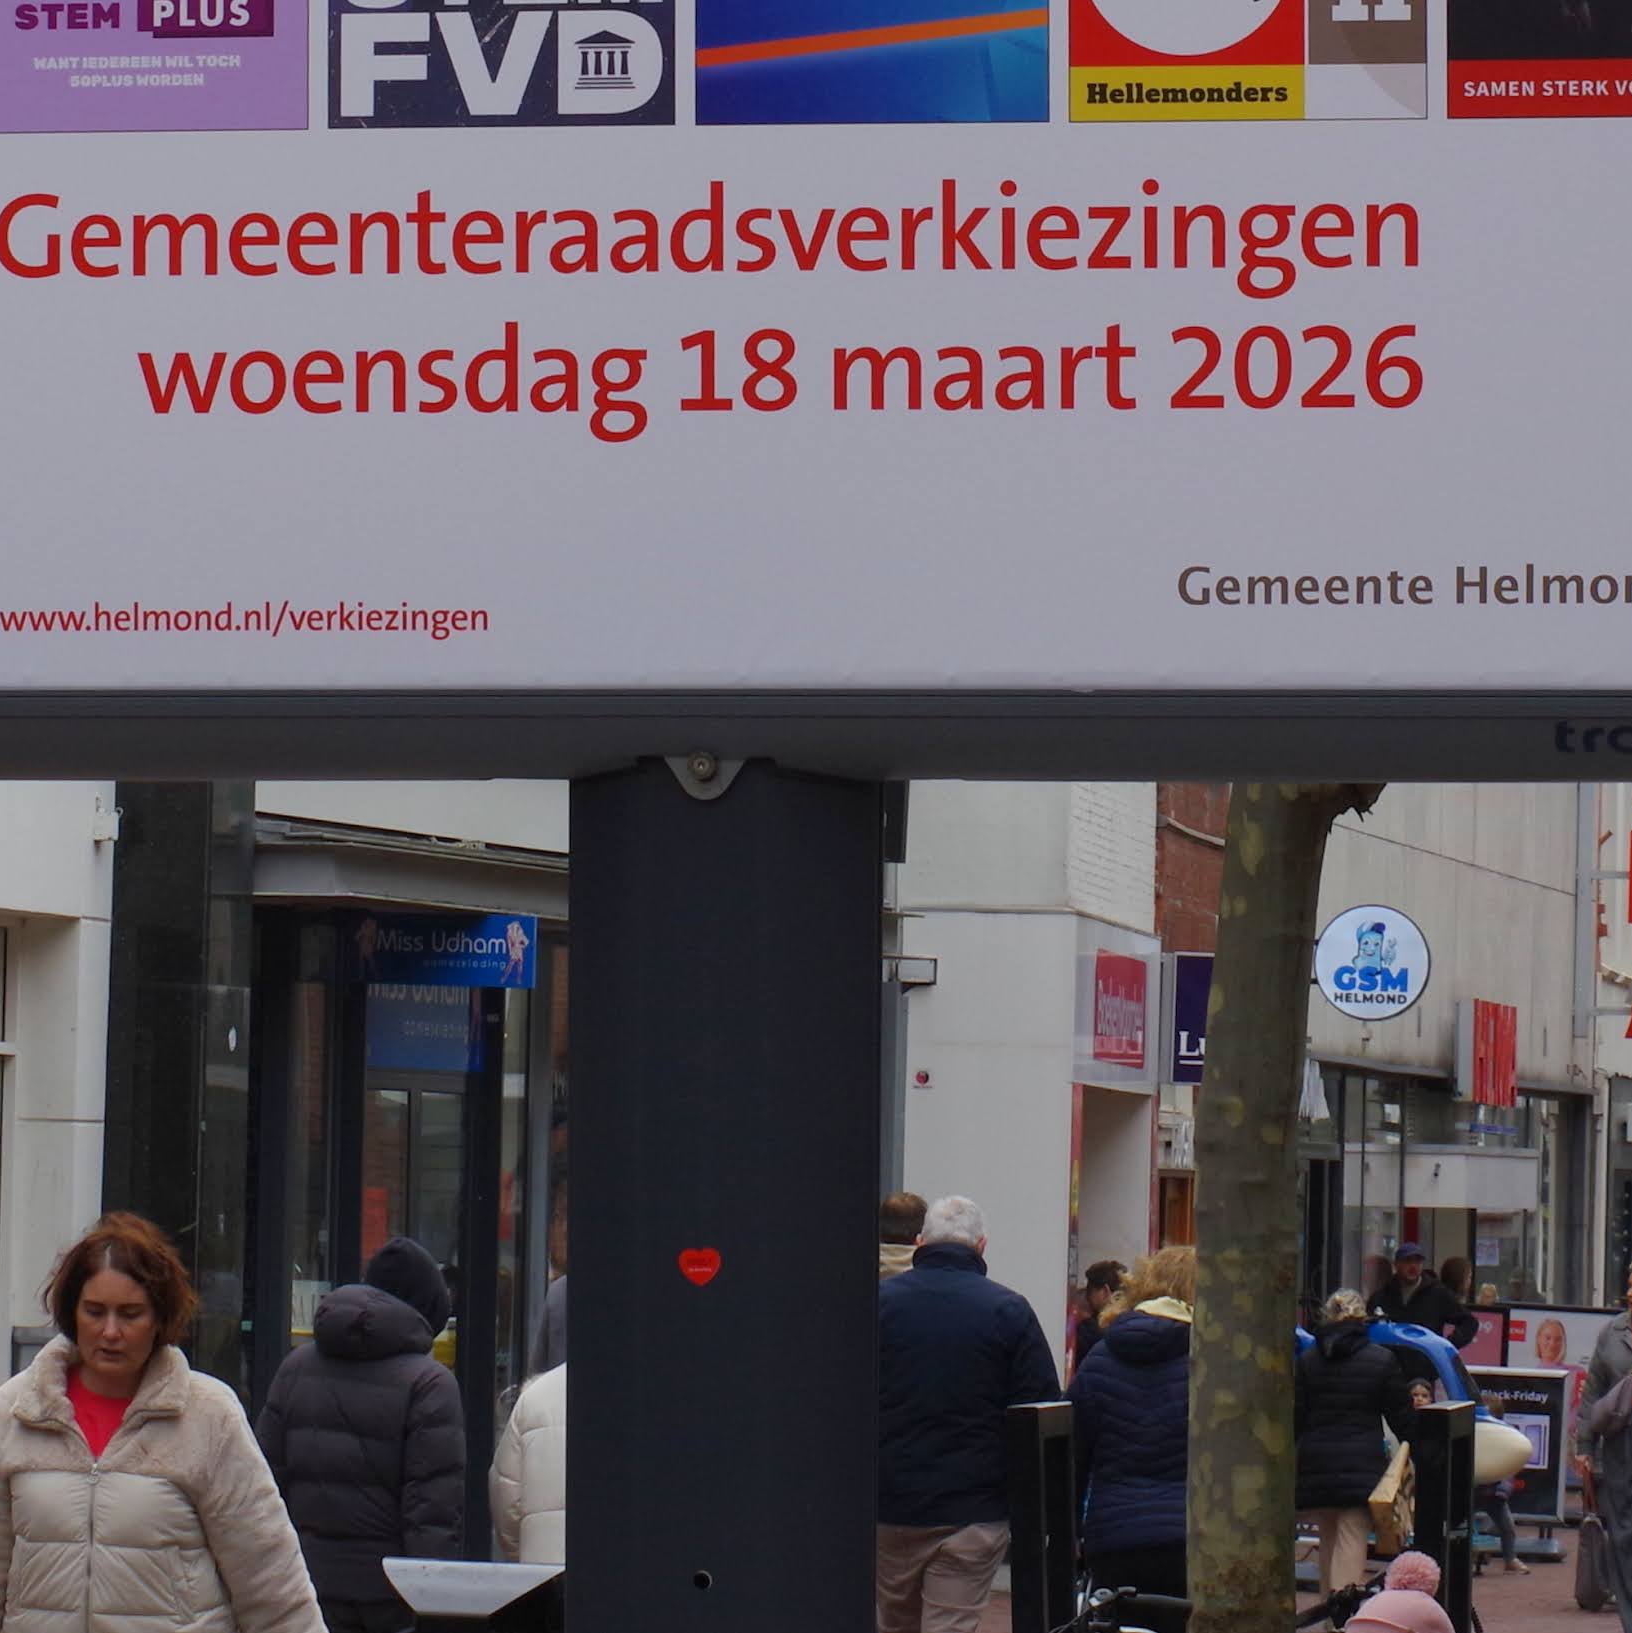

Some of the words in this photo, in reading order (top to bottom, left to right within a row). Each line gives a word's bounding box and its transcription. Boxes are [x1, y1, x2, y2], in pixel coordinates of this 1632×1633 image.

[14, 2, 121, 30] STEM
[33, 56, 79, 71] WANT
[82, 54, 162, 69] IEDEREEN
[165, 54, 194, 68] WIL
[196, 53, 241, 68] TOCH
[339, 11, 663, 118] FVD
[70, 74, 133, 88] 50PLUS
[136, 73, 205, 87] WORDEN
[1086, 80, 1288, 106] Hellemonders
[1464, 77, 1535, 97] SAMEN
[1542, 77, 1609, 96] STERK
[139, 322, 649, 444] woensdag
[678, 329, 799, 413] 18
[832, 323, 1137, 412] maart
[1168, 323, 1425, 410] 2026
[1177, 562, 1435, 609] Gemeente
[0, 600, 489, 641] www.helmond.nl/verkiezingen
[376, 929, 423, 953] Miss
[431, 930, 506, 955] Udham
[1334, 966, 1409, 992] GSM
[1334, 992, 1407, 1005] HELMOND
